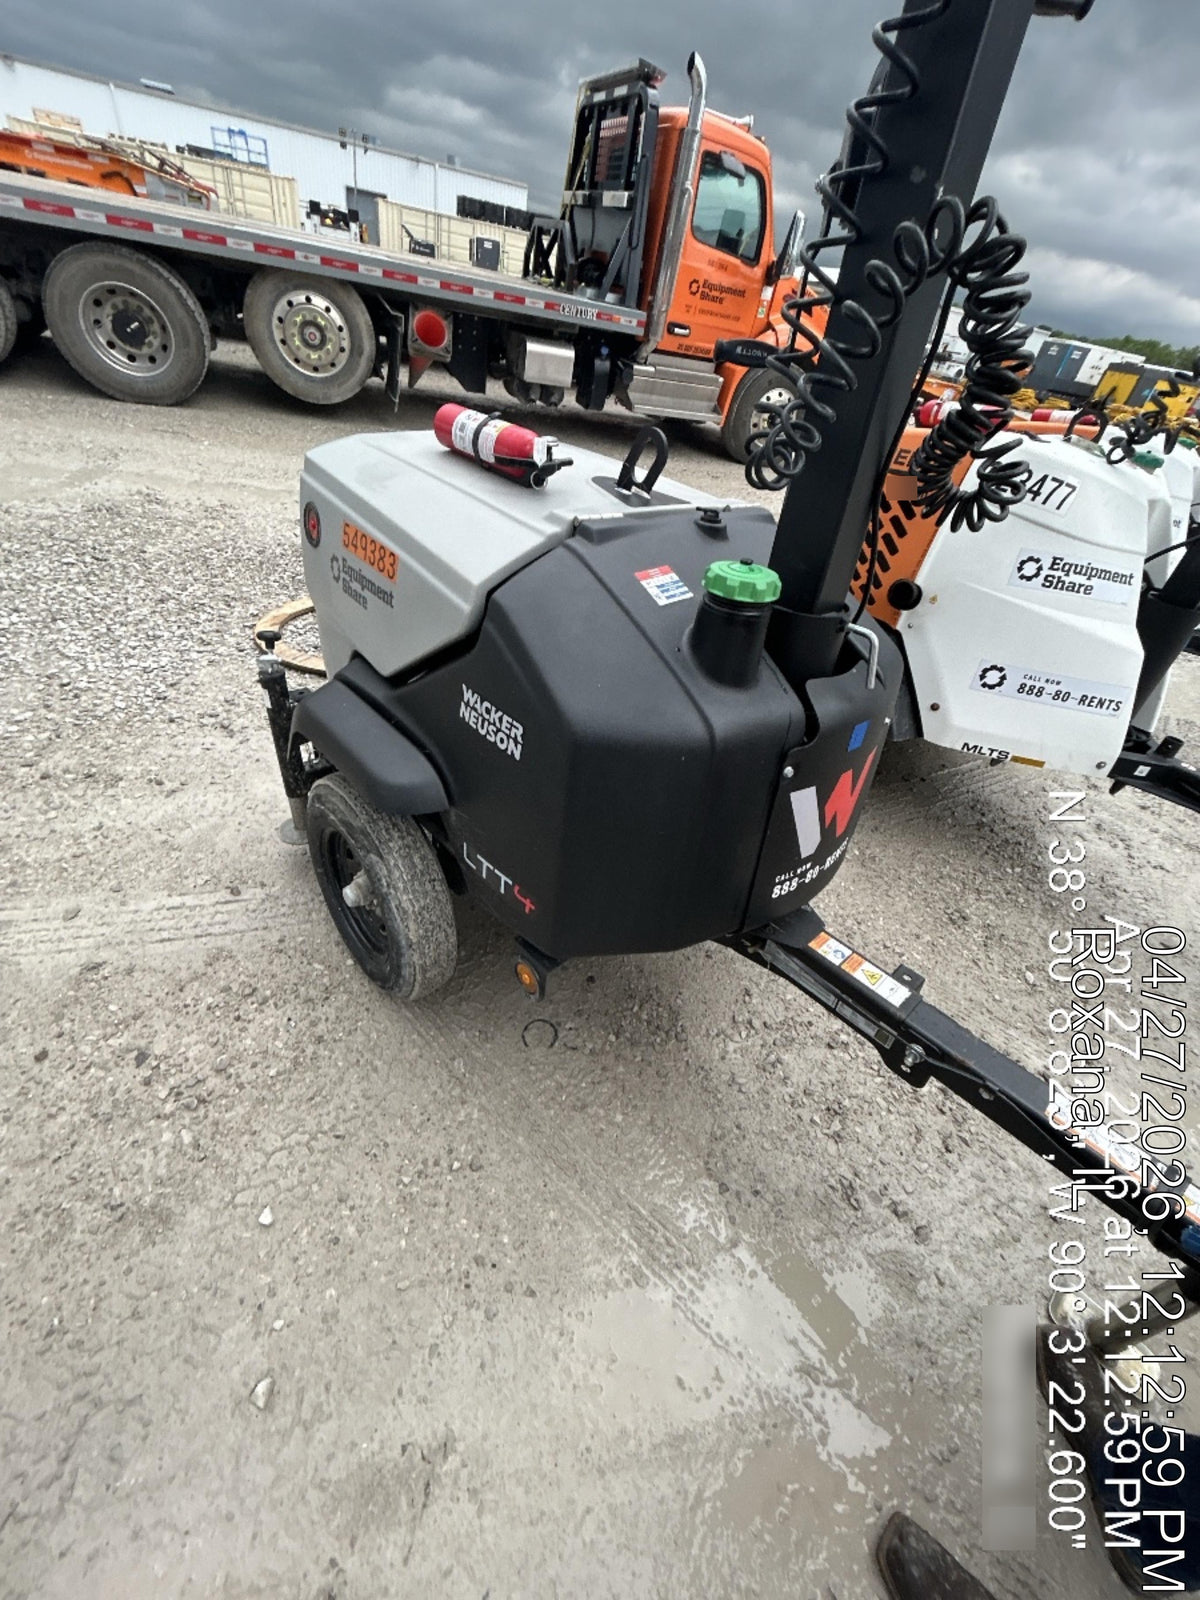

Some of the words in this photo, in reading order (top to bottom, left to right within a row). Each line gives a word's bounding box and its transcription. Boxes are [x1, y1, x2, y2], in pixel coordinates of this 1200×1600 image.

[700, 290, 724, 304] Share
[702, 279, 746, 298] Equipment
[560, 303, 598, 320] CENTURY
[343, 522, 396, 580] 549383
[342, 557, 395, 609] Equipment
[1048, 556, 1134, 586] Equipment
[342, 577, 368, 610] Share
[1041, 574, 1094, 595] Share
[1023, 674, 1041, 683] CALL
[1044, 678, 1062, 686] NOW
[1017, 682, 1123, 712] 888-80-RENTS
[462, 683, 523, 744] WACKER
[460, 701, 522, 761] NEUSON
[961, 742, 1010, 760] MLTS
[776, 870, 794, 883] CALL
[796, 861, 812, 875] NOW
